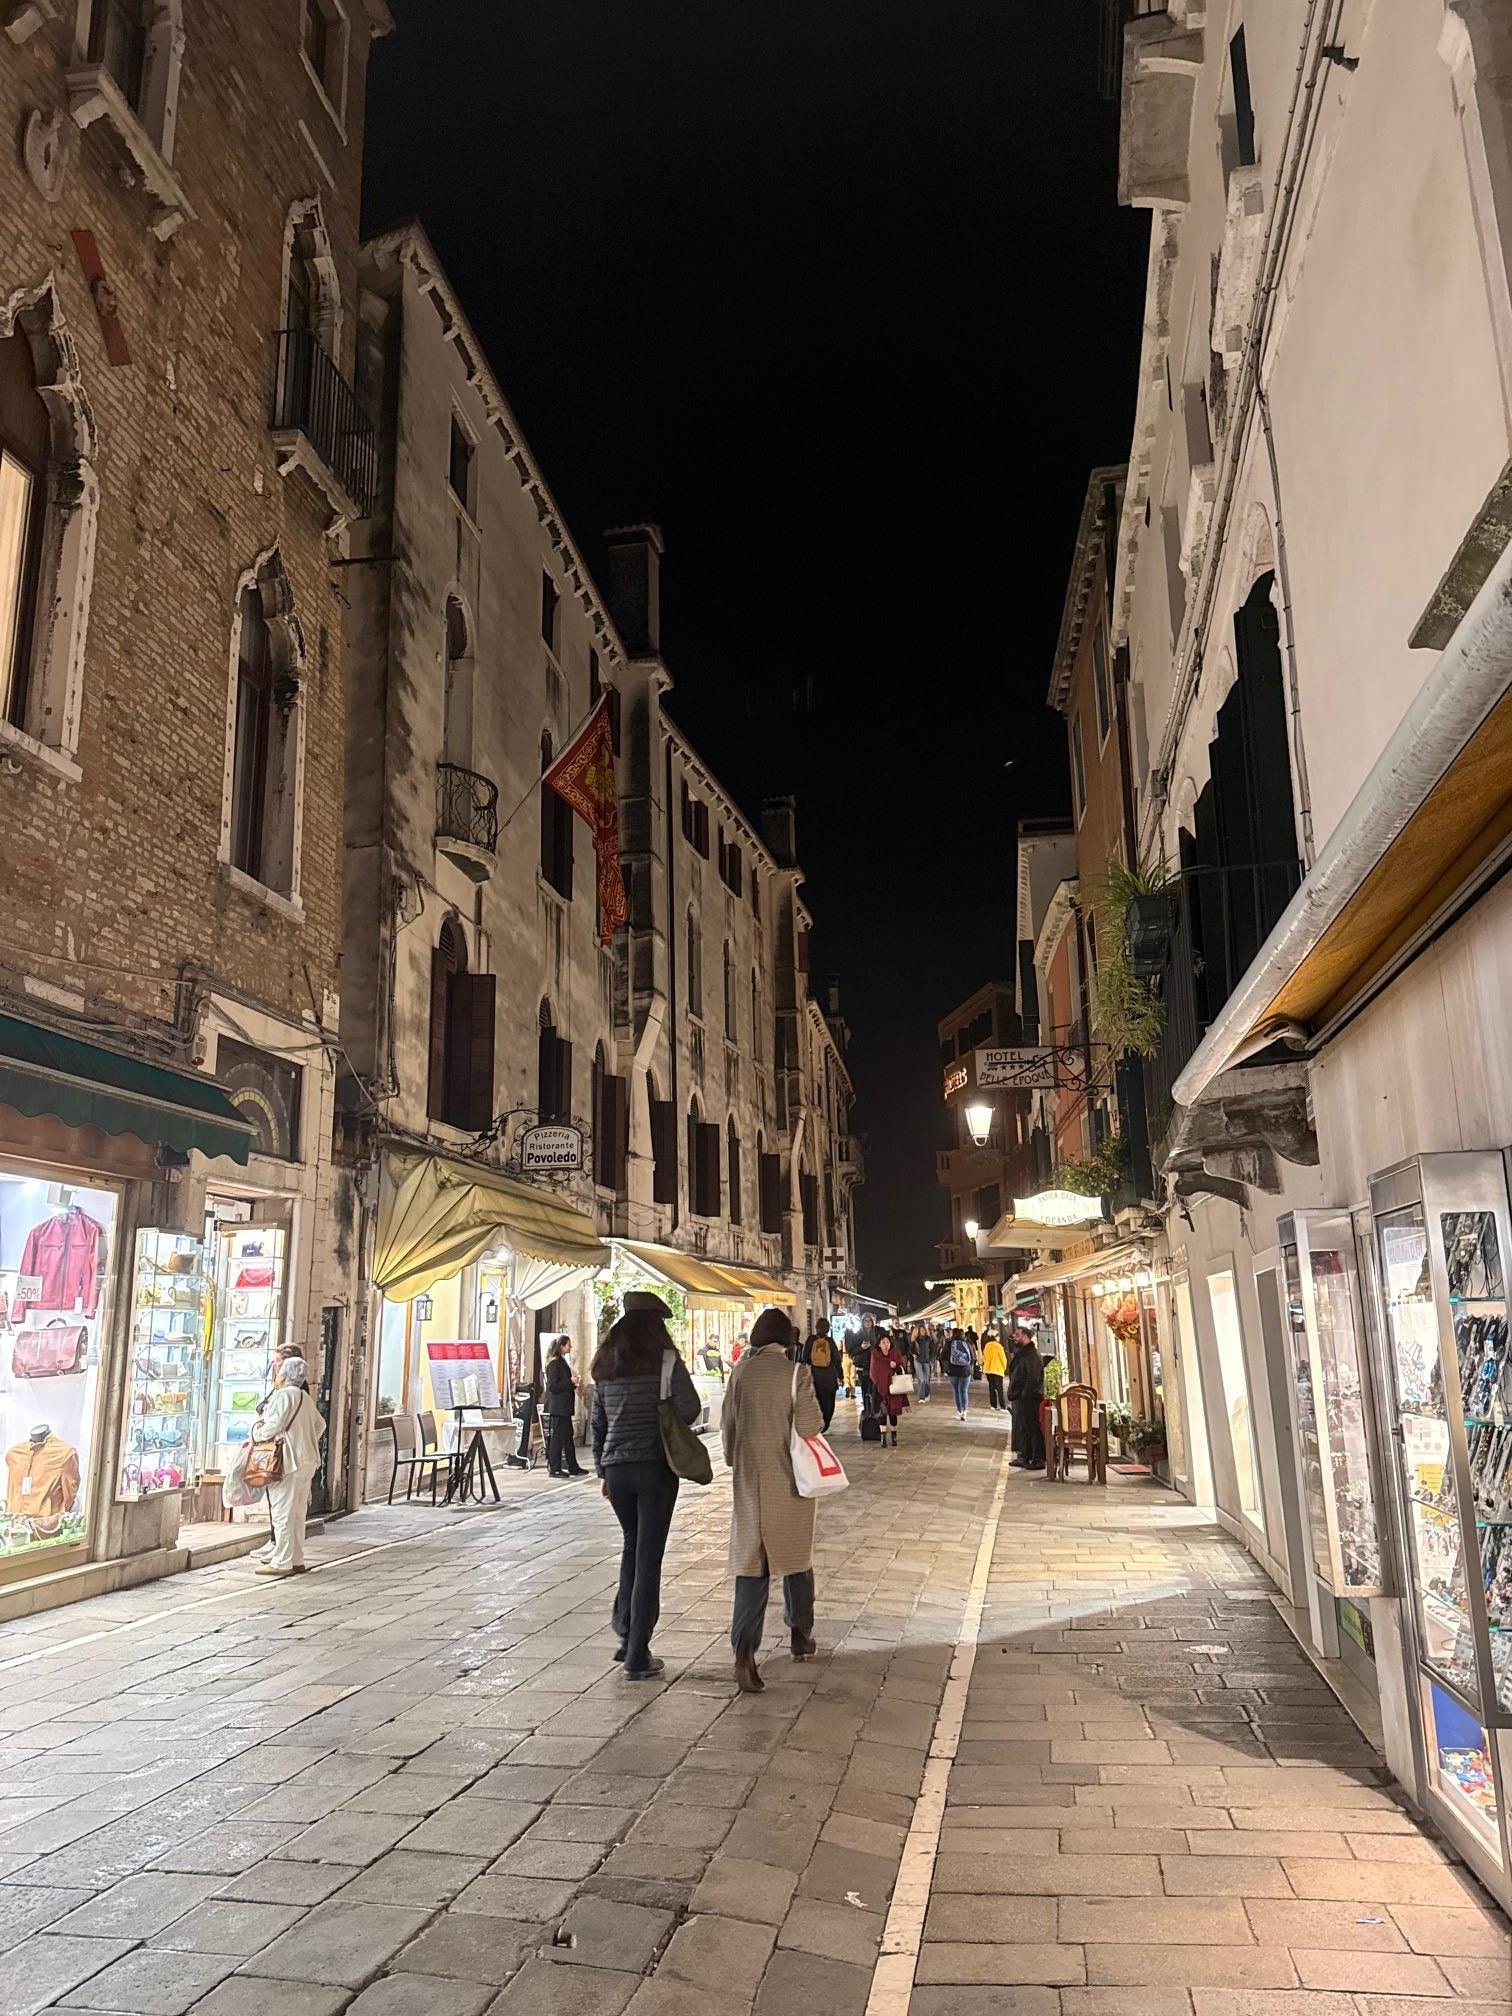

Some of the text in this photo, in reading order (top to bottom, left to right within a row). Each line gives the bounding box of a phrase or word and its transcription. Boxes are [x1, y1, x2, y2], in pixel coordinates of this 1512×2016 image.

[986, 1051, 1024, 1061] HOTEL
[980, 1072, 1008, 1085] BELLE
[534, 1131, 570, 1140] Pizzeria
[529, 1142, 574, 1150] Ristorante
[527, 1151, 577, 1164] Povoledo
[17, 1287, 40, 1300] -50%
